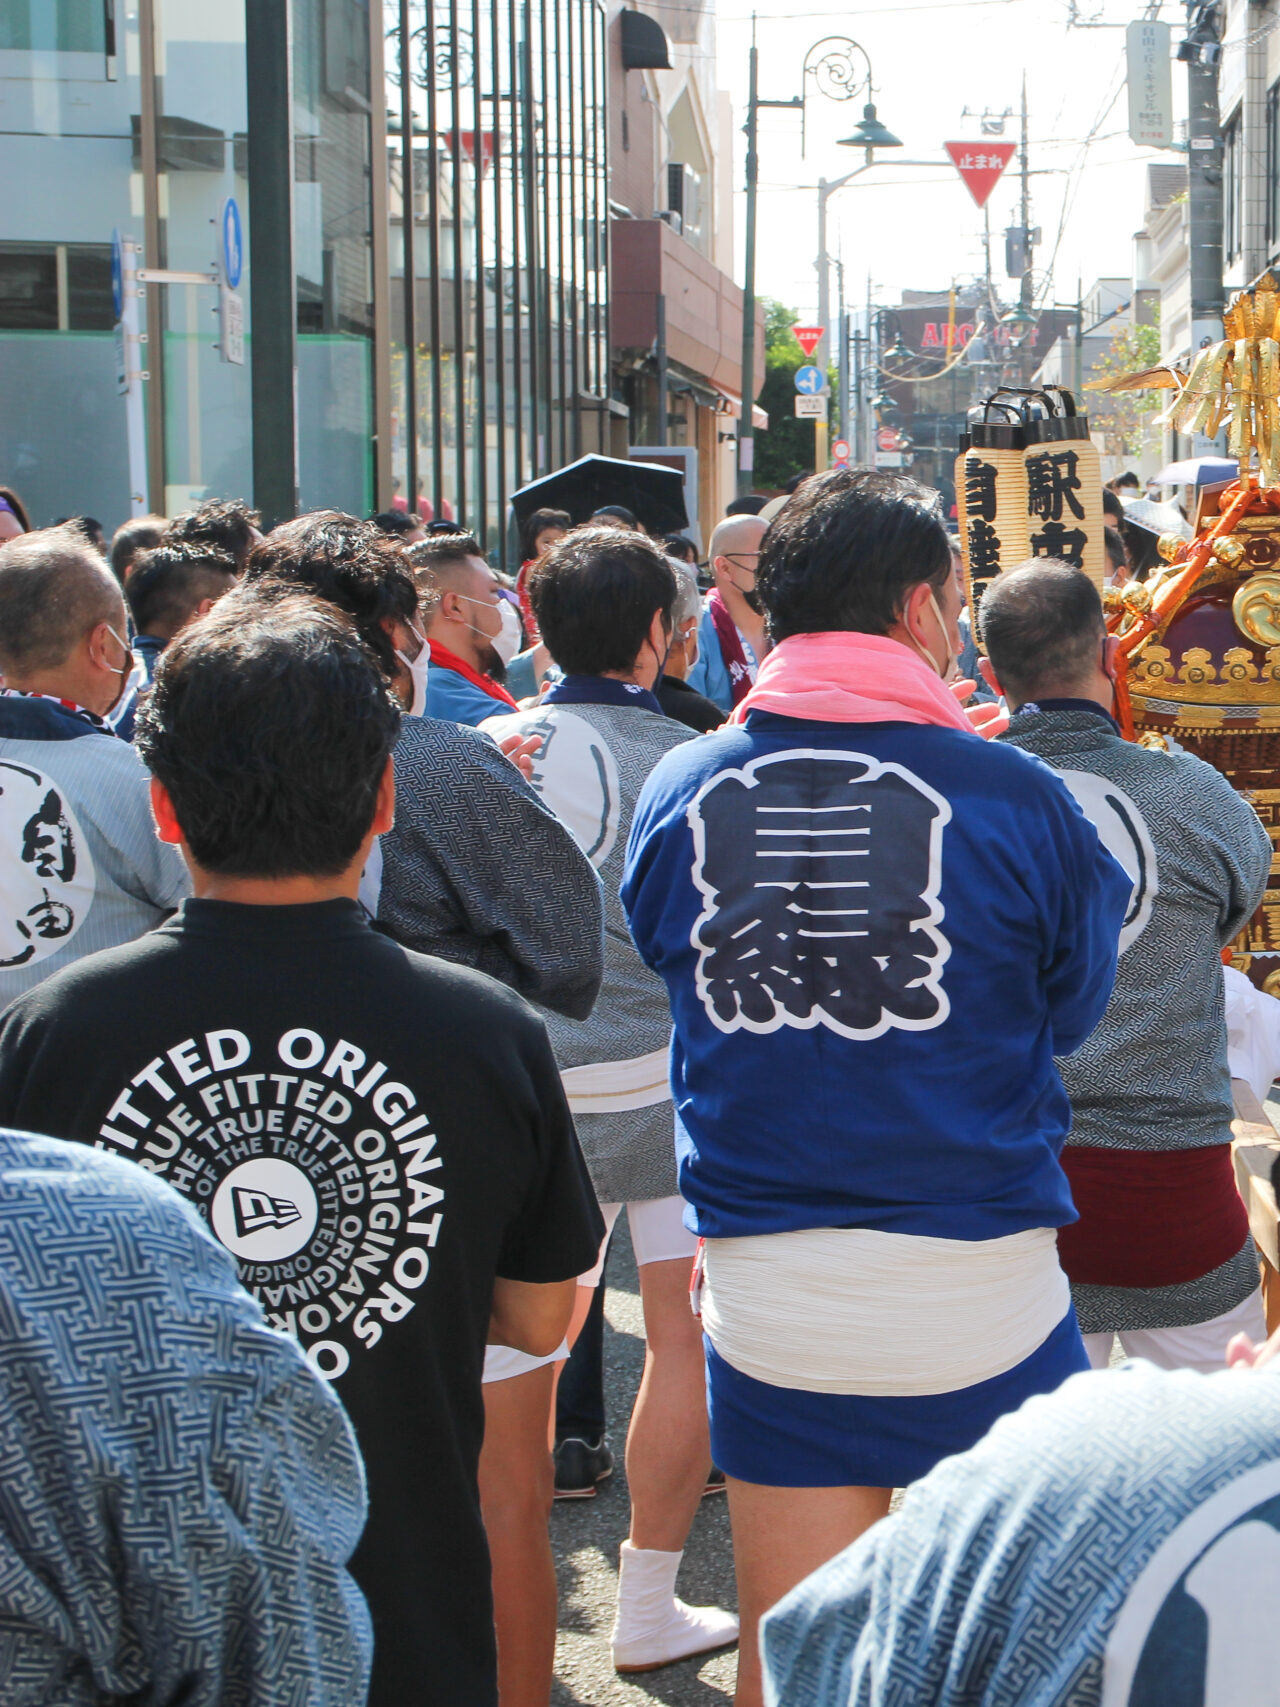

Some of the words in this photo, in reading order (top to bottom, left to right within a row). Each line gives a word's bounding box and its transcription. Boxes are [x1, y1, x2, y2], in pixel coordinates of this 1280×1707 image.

[959, 153, 1003, 169] 止まれ
[199, 1074, 352, 1124] FITTED
[196, 1110, 285, 1150] TRUE
[290, 1115, 364, 1205] FITTED
[196, 1164, 218, 1196] OF
[215, 1137, 263, 1167] THE
[269, 1136, 328, 1178] TRUE
[310, 1178, 340, 1257] FITTED
[278, 1028, 445, 1350] ORIGINATORS
[262, 1129, 401, 1338] ORIGINATOR
